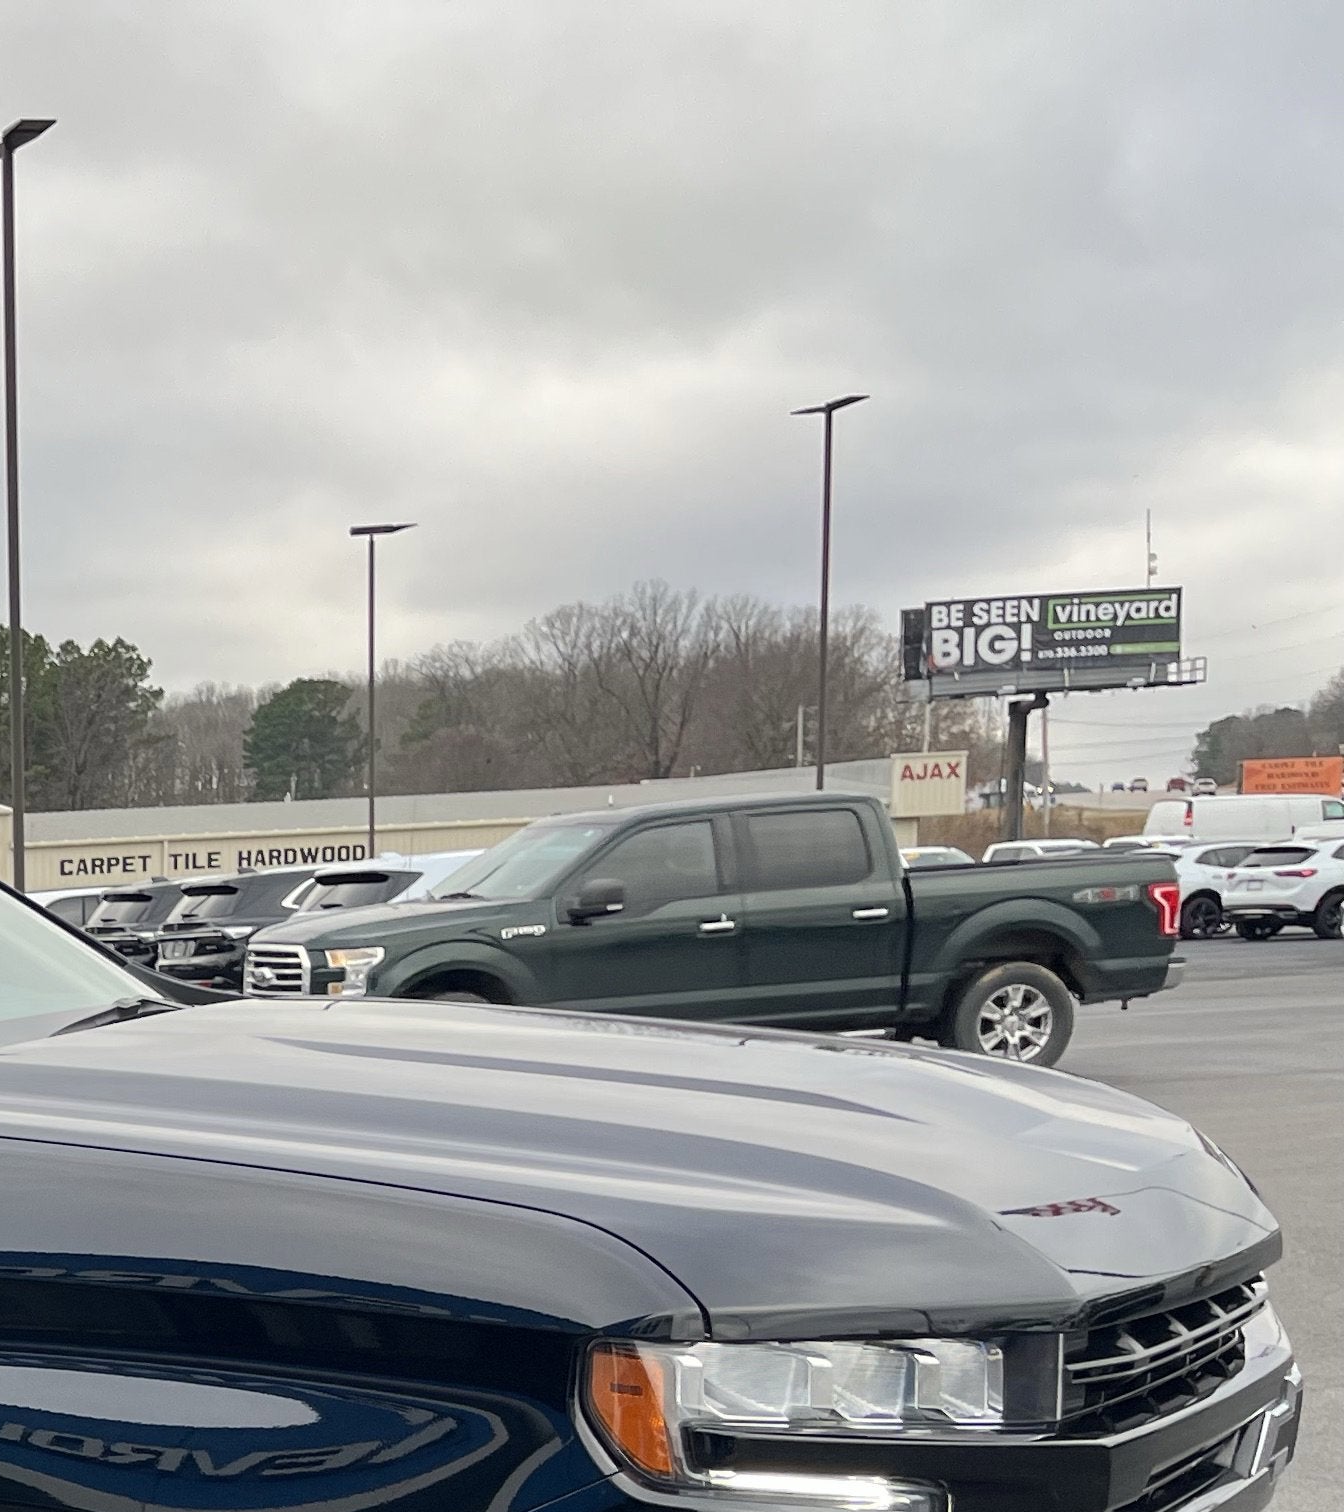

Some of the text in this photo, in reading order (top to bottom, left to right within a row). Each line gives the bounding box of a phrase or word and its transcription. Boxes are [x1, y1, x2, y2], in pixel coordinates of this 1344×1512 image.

[930, 598, 1041, 629] BE SEEN
[1055, 593, 1178, 627] vineyard
[931, 622, 1032, 669] BIG!
[1053, 628, 1112, 641] OUTDOOR
[901, 762, 960, 781] AJAX
[60, 844, 366, 877] CARPET TILE HARDWOOD
